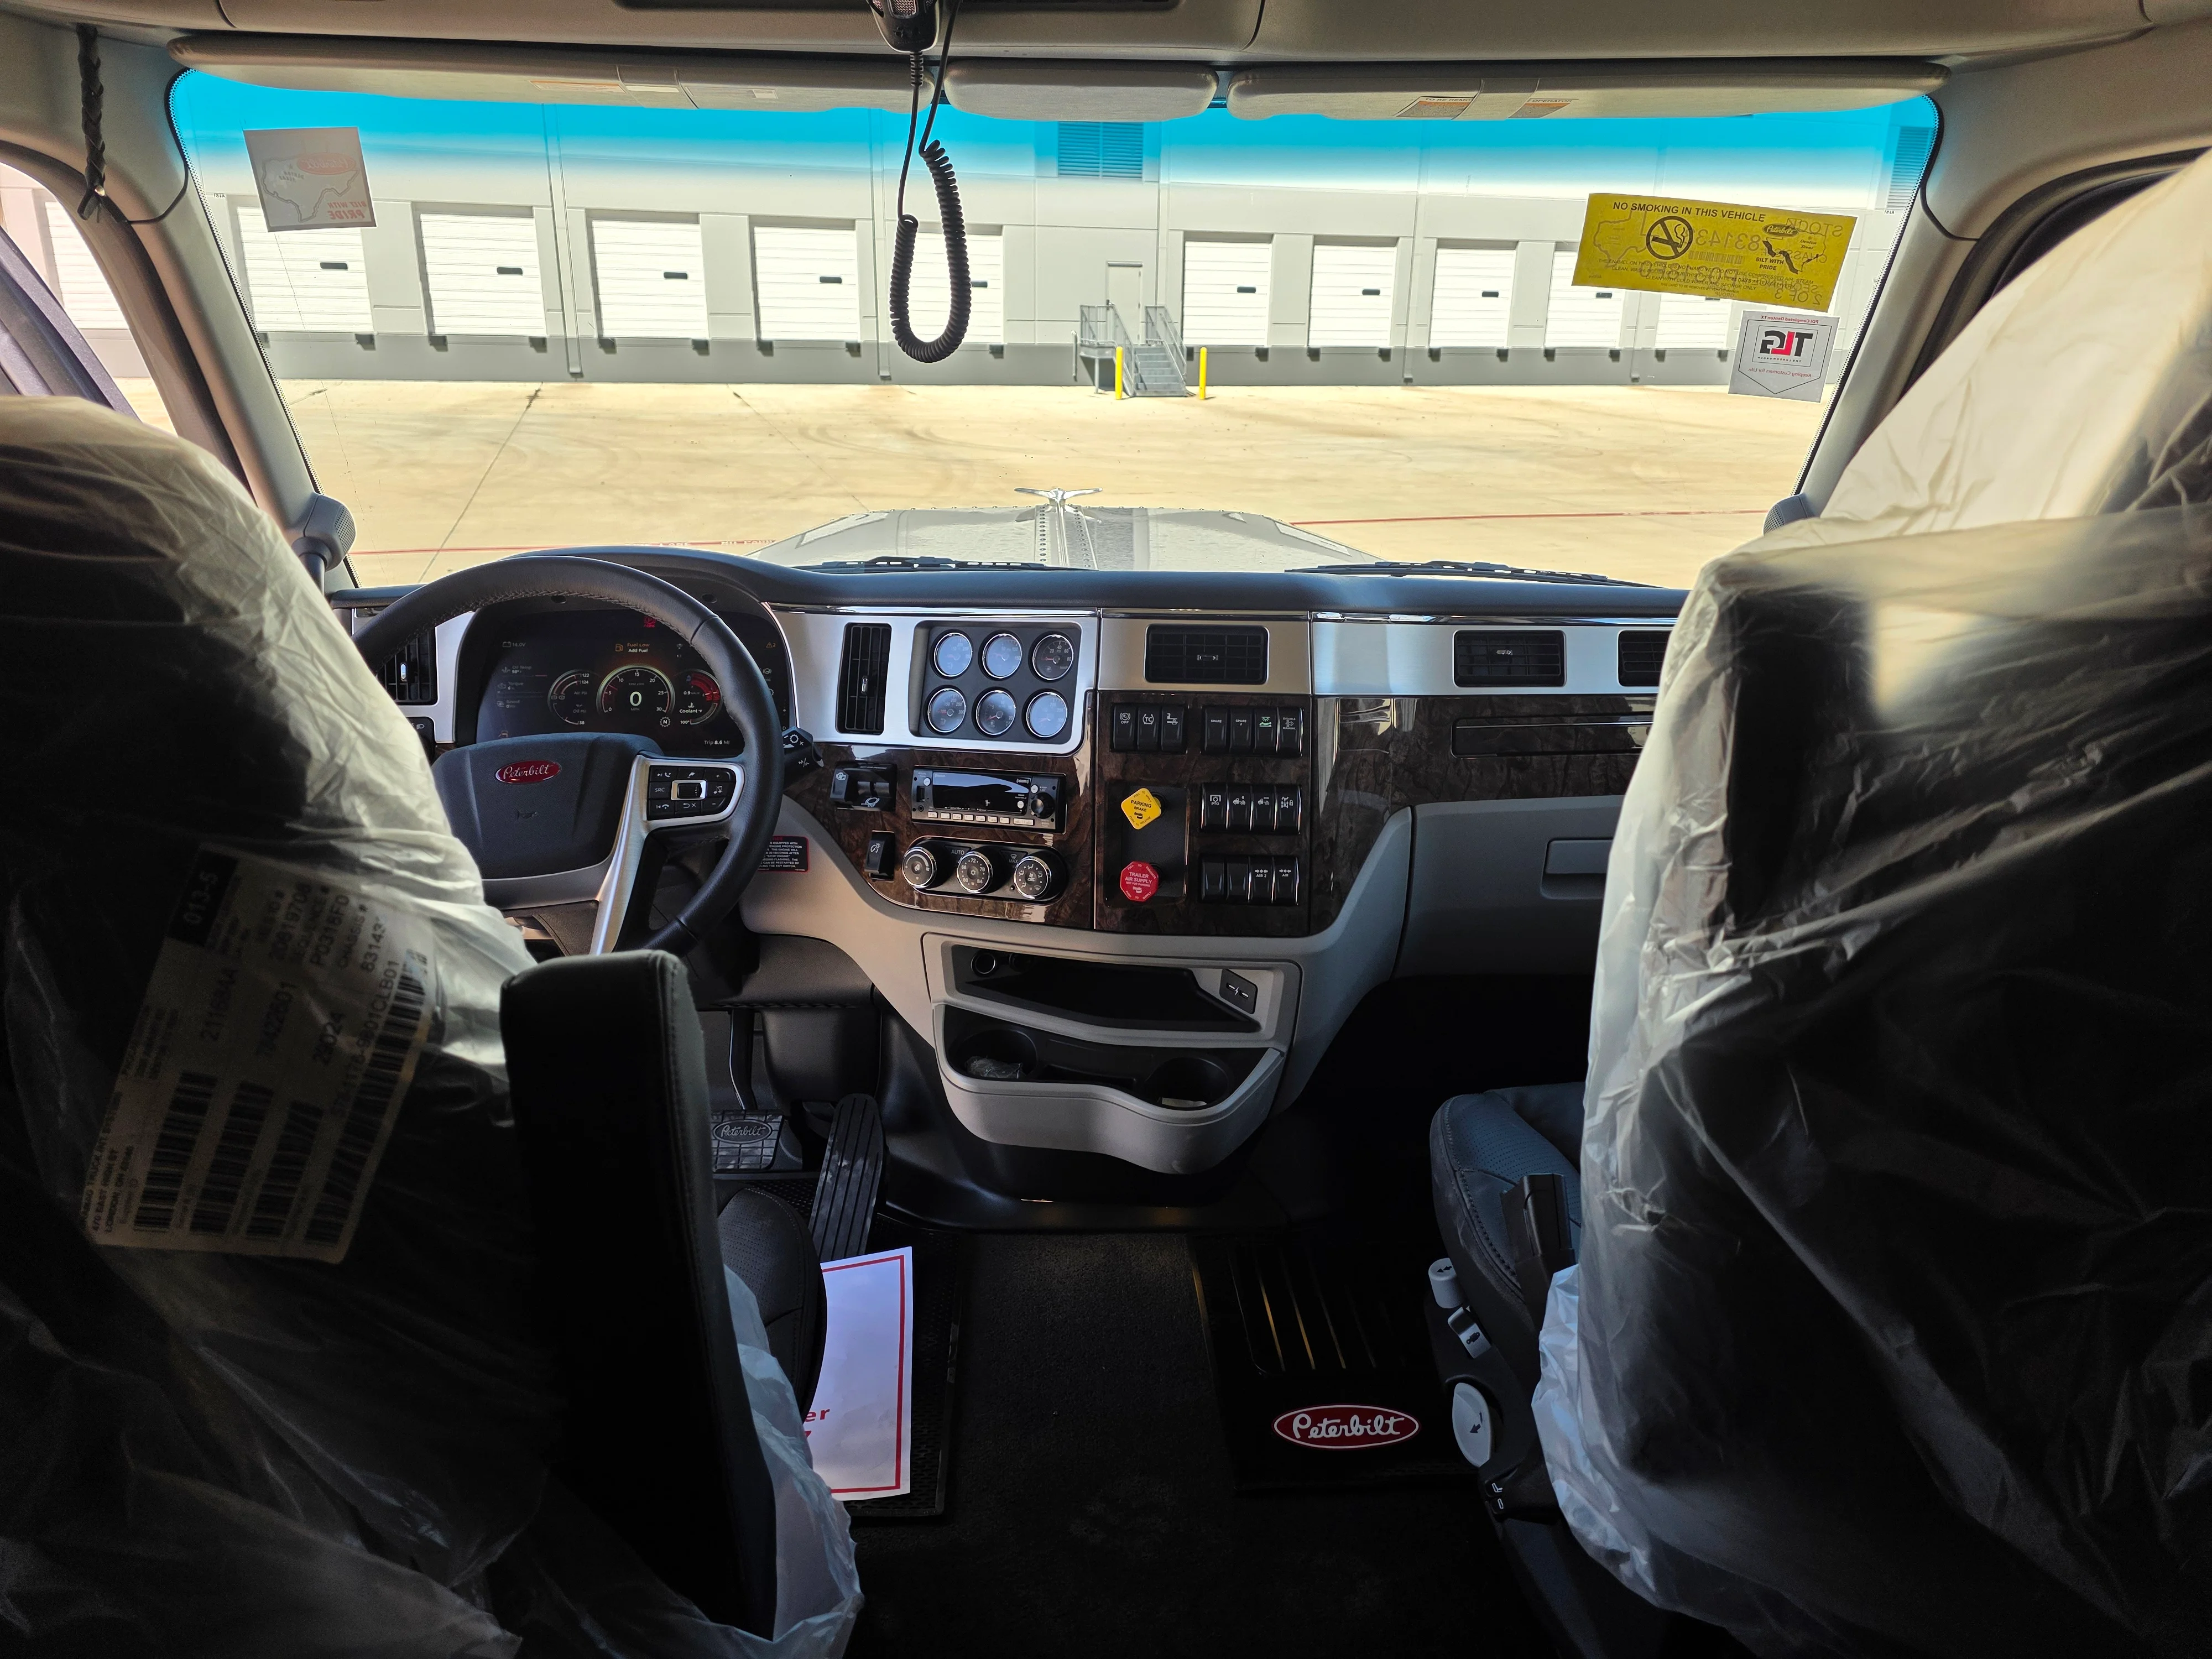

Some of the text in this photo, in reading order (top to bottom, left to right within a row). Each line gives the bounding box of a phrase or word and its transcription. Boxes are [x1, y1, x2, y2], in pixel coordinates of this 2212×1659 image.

[1613, 202, 1766, 222] NO SMOKING IN THIS VEHICLE
[1766, 225, 1793, 236] Peterbilt
[1748, 272, 1784, 281] COMPRESSED
[629, 691, 642, 706] 0
[503, 764, 550, 780] Peterbilt
[1130, 800, 1152, 808] PARKING
[721, 1124, 766, 1137] Peterbilt
[1292, 1412, 1405, 1439] Peterbilt
